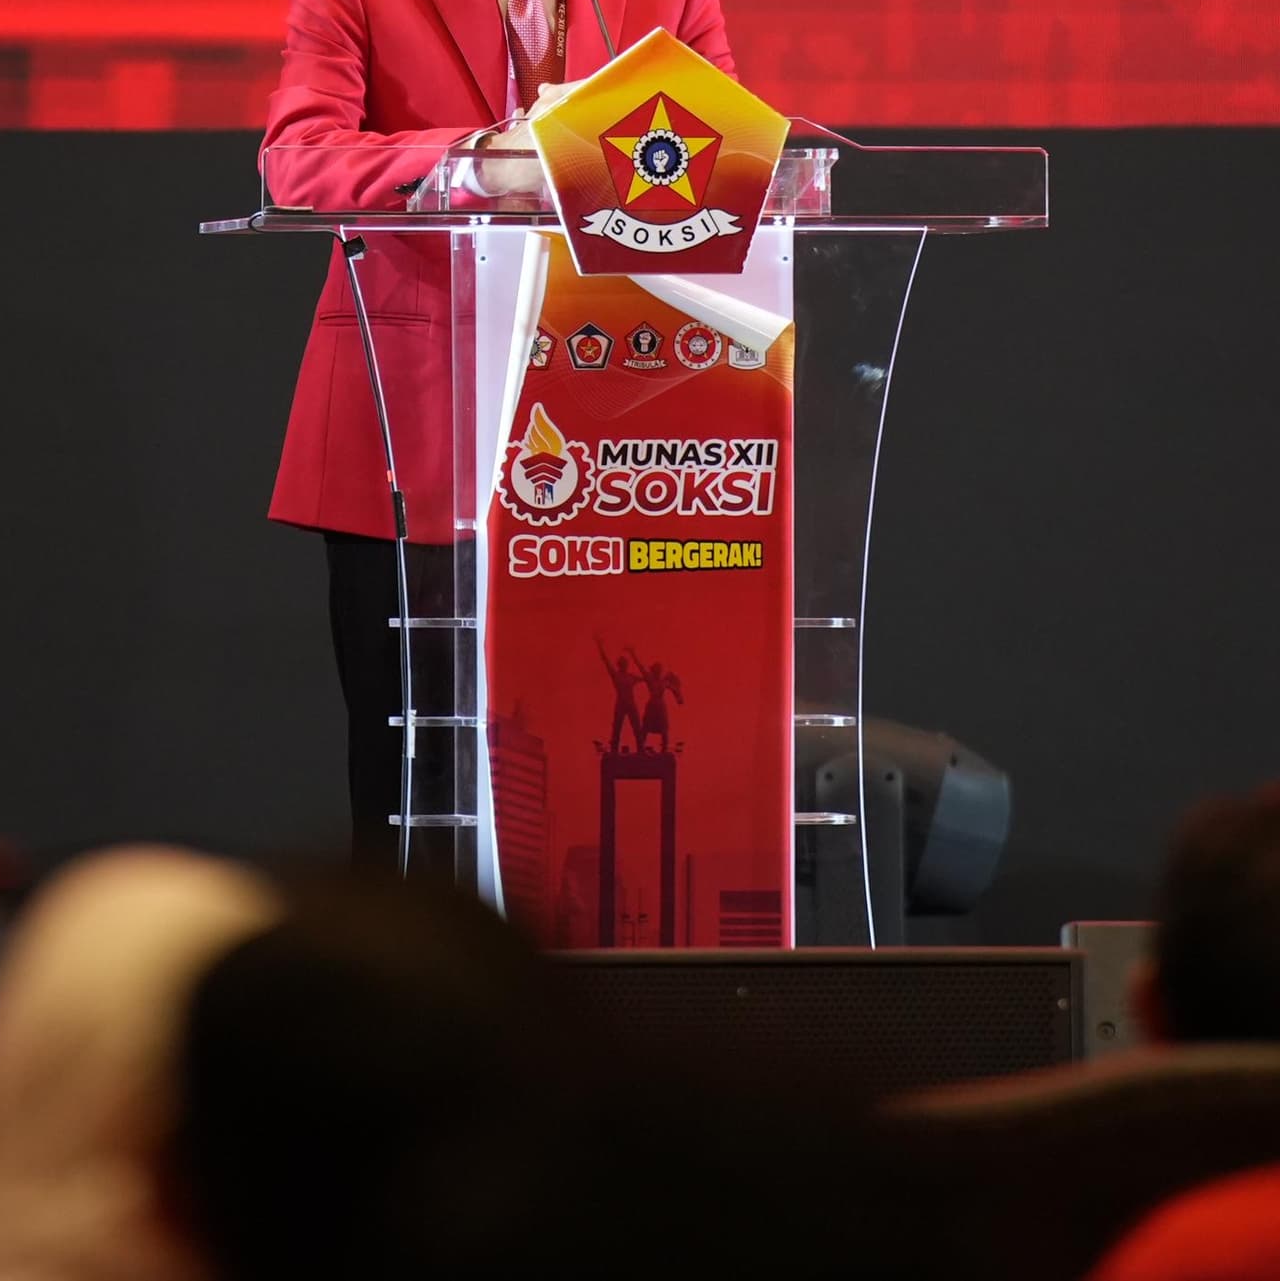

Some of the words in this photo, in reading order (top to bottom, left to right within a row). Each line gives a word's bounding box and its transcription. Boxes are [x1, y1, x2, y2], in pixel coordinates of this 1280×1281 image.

[556, 30, 565, 57] SOKSI
[611, 218, 711, 246] SOKSI
[600, 441, 722, 467] MUNAS
[731, 441, 776, 467] XII
[595, 469, 775, 514] SOKSI
[511, 537, 621, 575] SOKSI
[629, 541, 762, 570] BERGERAK!
